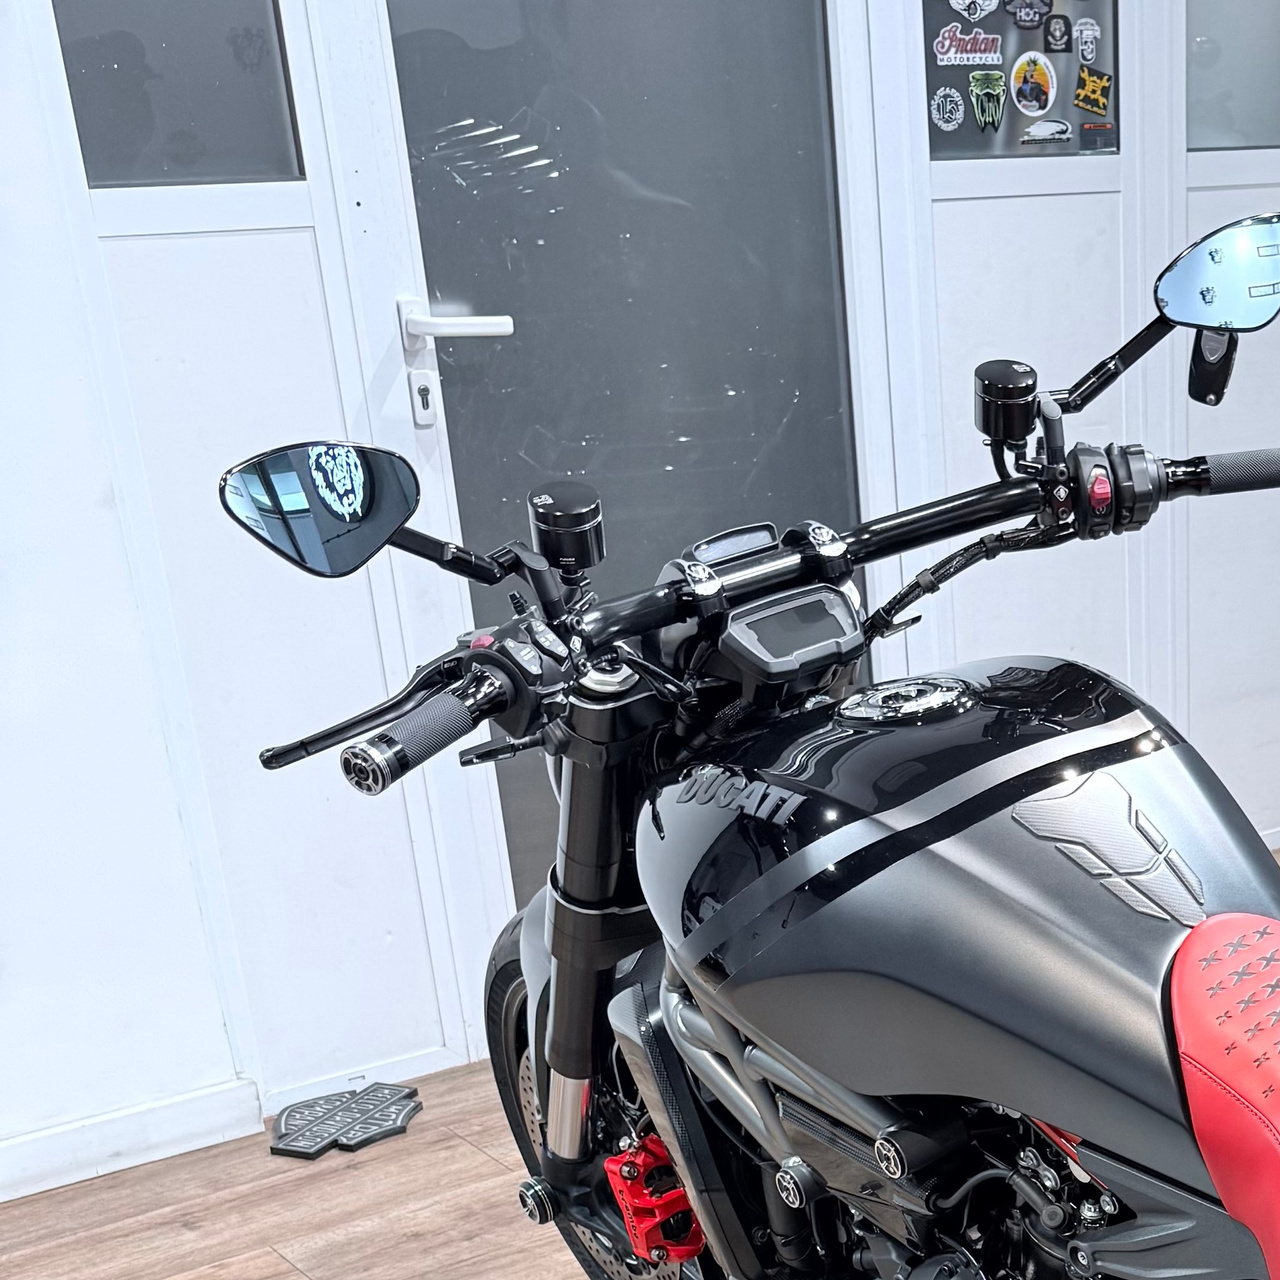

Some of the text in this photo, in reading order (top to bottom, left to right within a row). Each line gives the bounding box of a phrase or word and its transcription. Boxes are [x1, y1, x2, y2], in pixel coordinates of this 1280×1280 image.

[935, 25, 999, 55] Indian
[938, 56, 1001, 64] MOTORCYCLE
[676, 768, 808, 827] DUCATI
[348, 1104, 403, 1139] MOTOR
